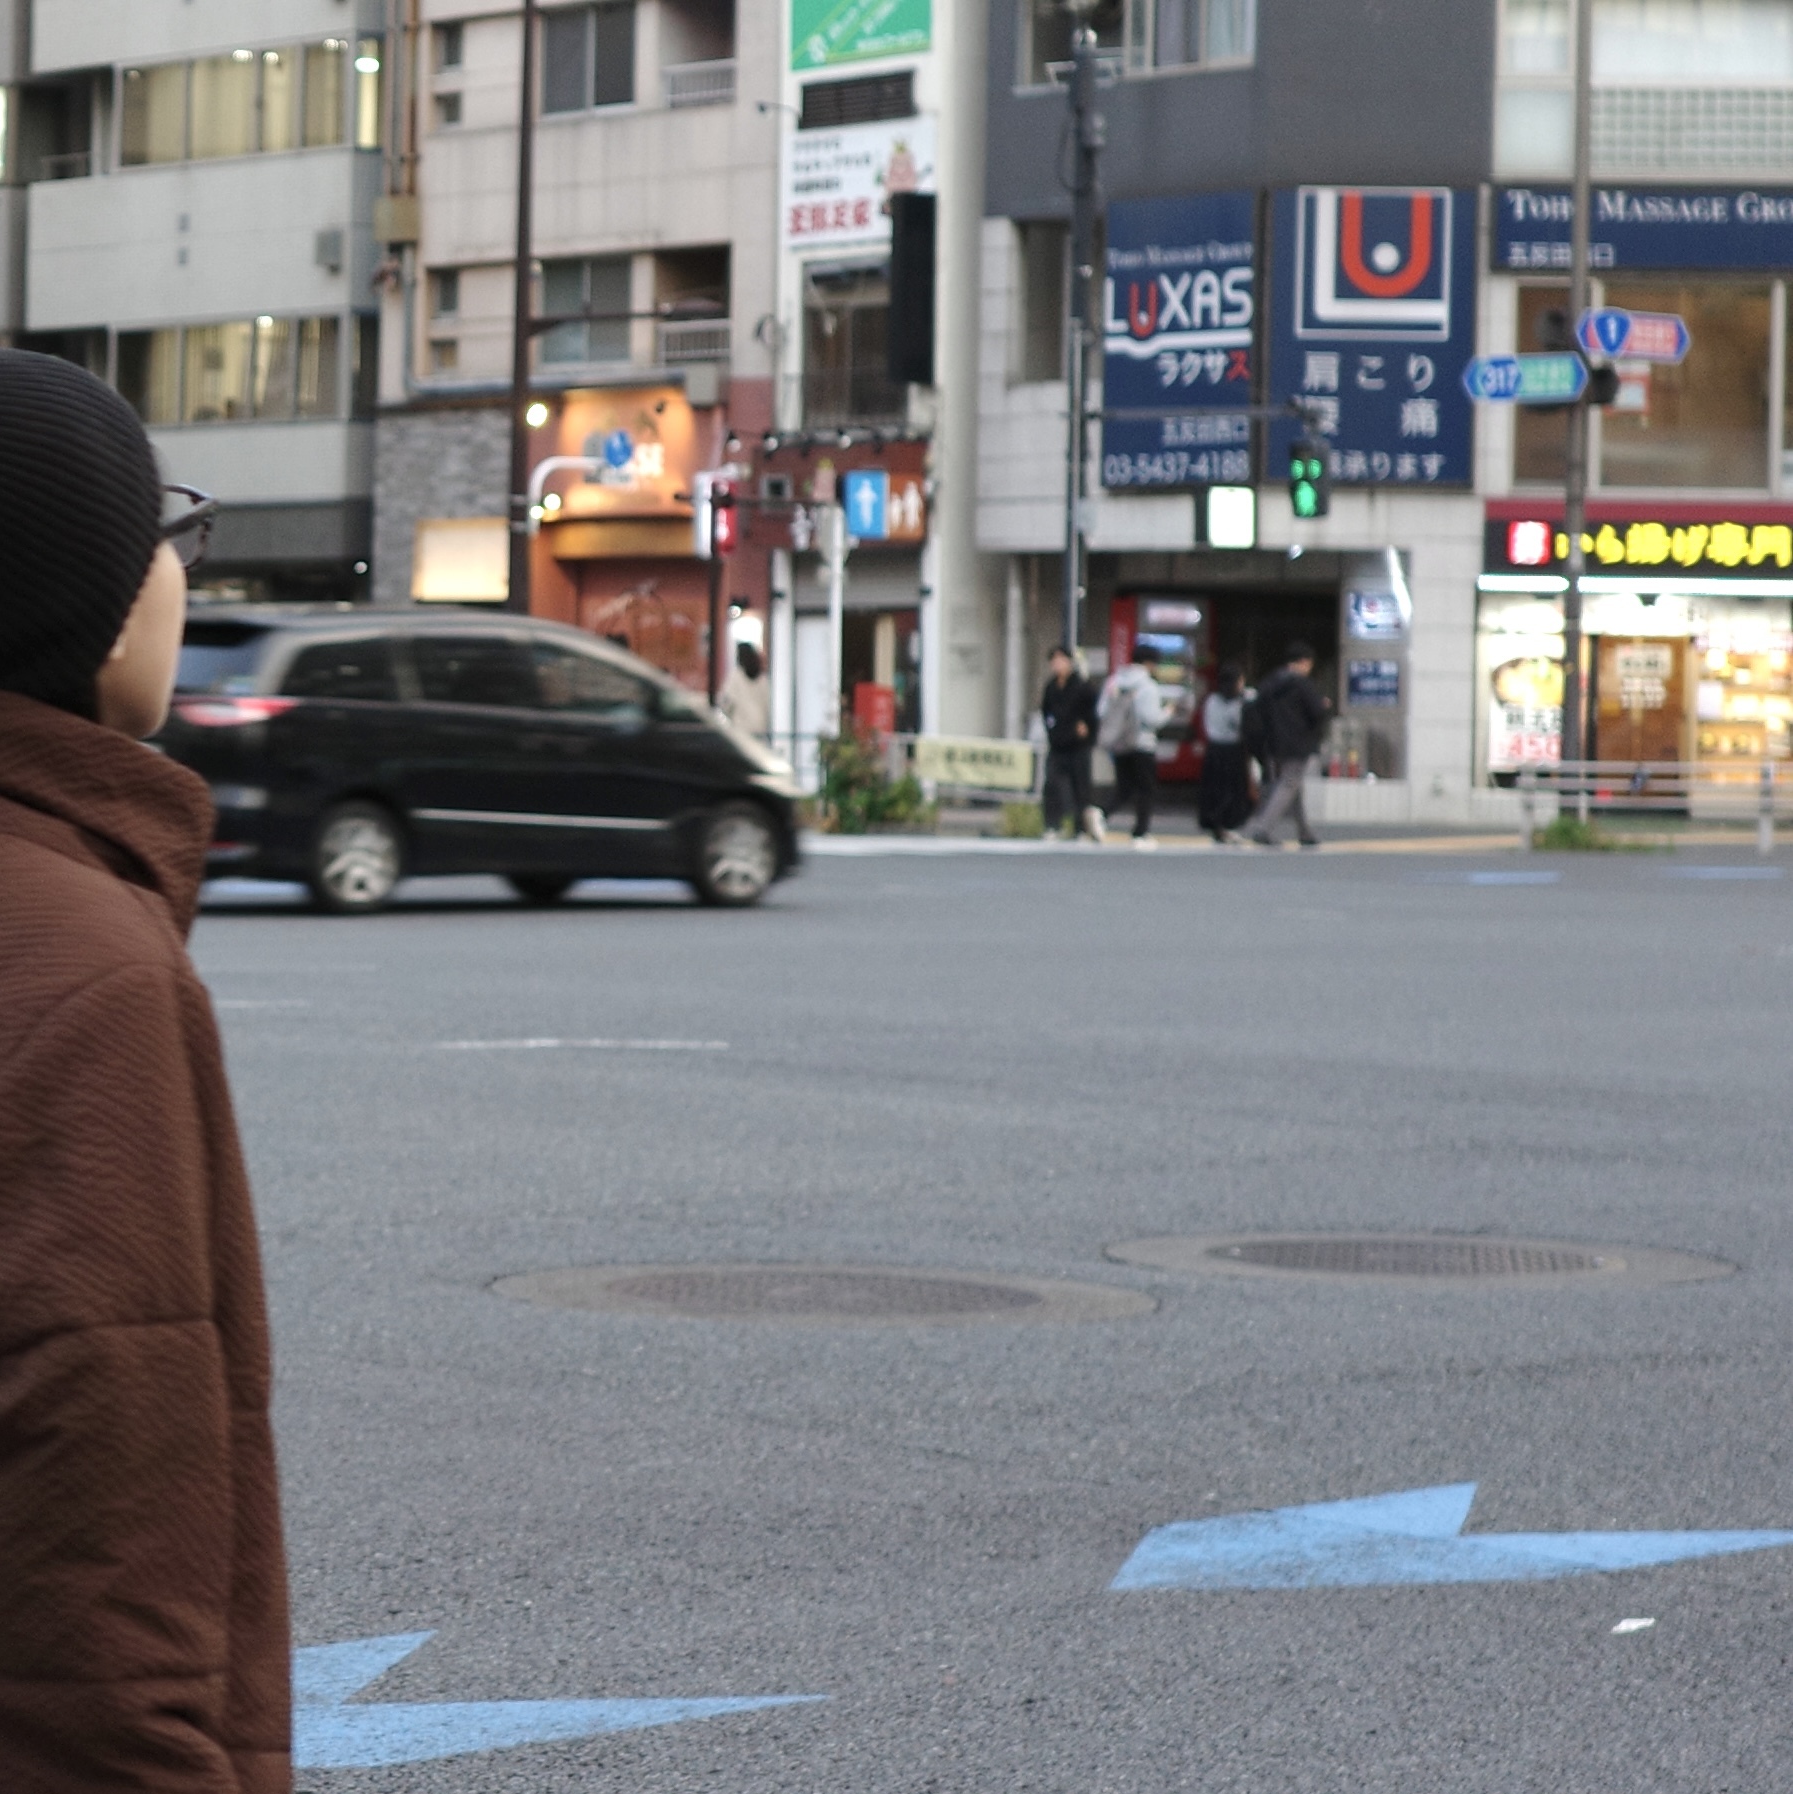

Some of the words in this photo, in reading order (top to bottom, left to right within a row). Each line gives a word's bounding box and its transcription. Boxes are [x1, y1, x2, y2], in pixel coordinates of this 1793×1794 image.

[1507, 188, 1574, 222] TOH
[1597, 188, 1729, 223] MASSAGE
[1508, 241, 1615, 268] 五反田口
[1105, 266, 1254, 338] LUXAS
[1157, 350, 1251, 388] ラクサス
[1303, 350, 1435, 393] 肩こり
[1481, 362, 1517, 395] 317
